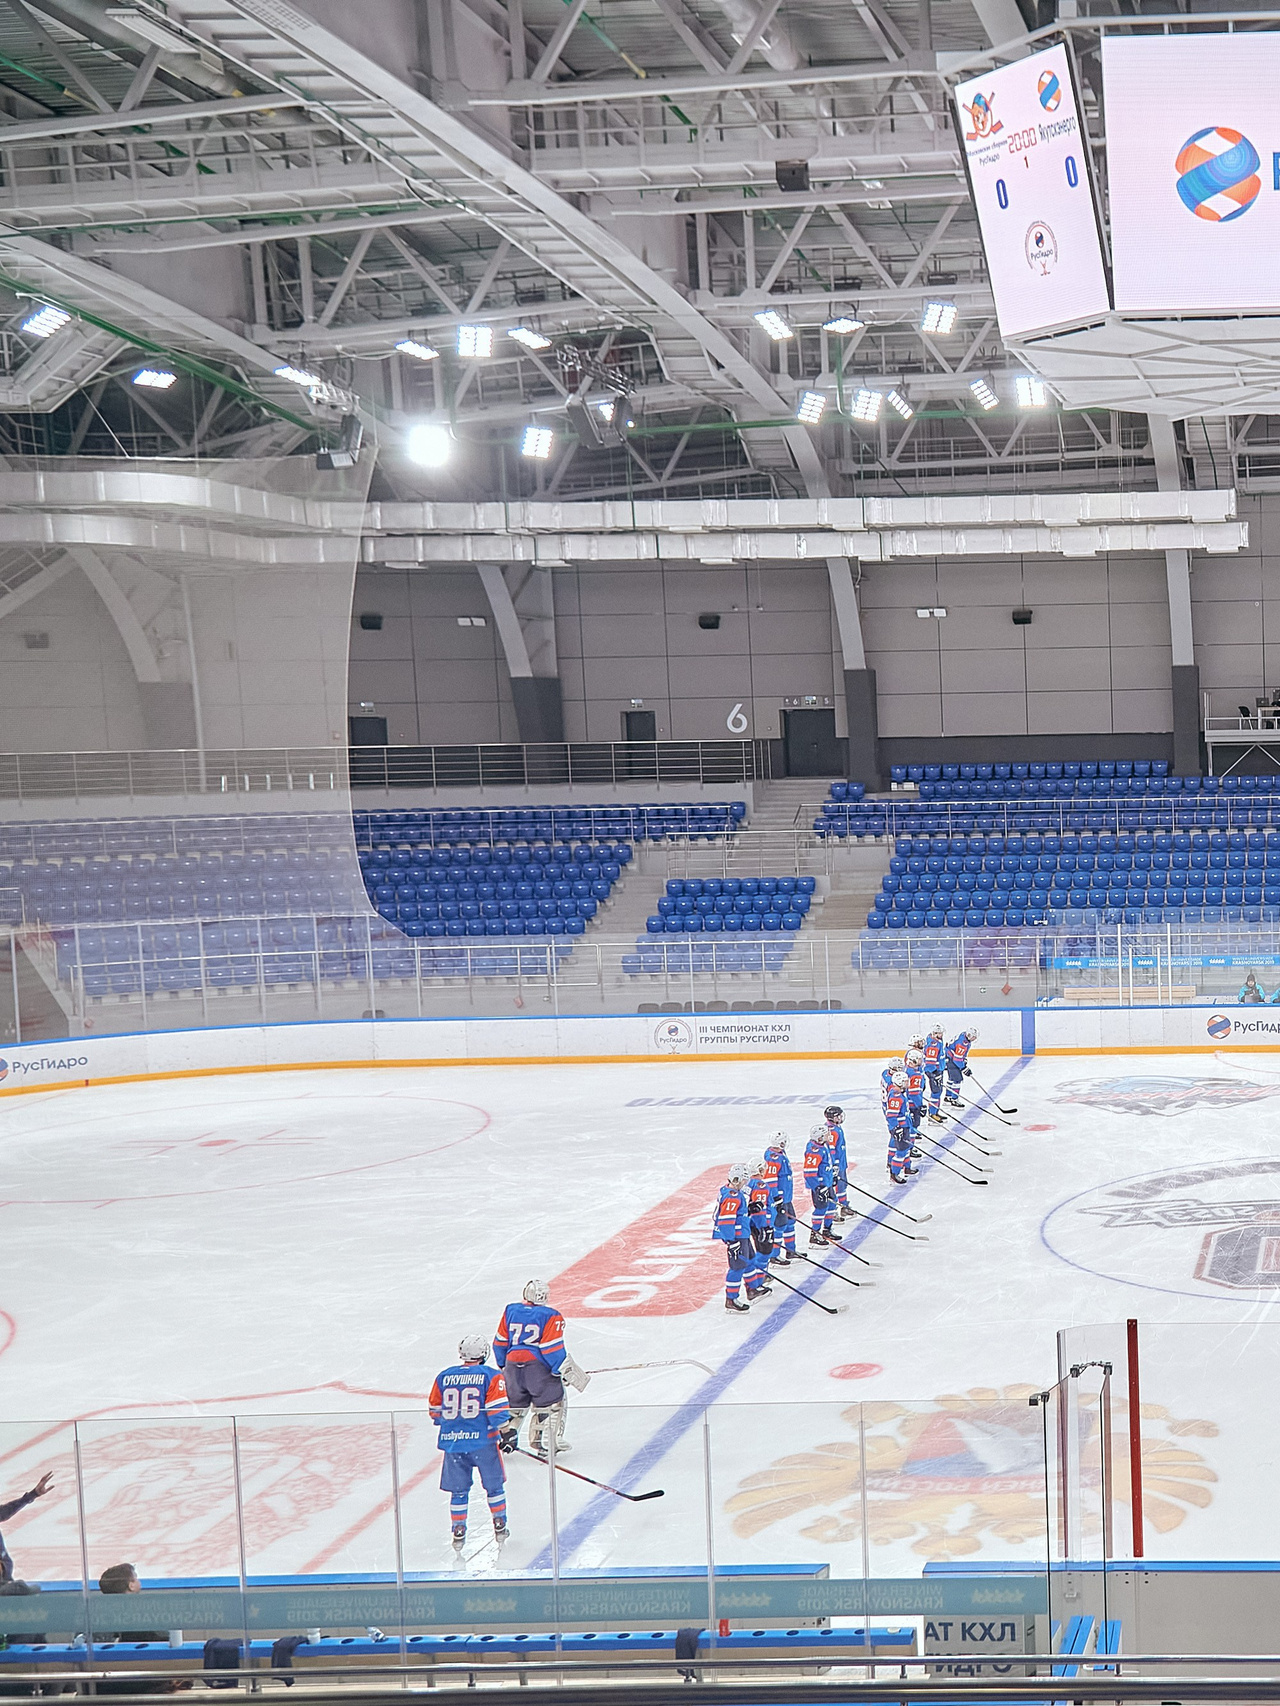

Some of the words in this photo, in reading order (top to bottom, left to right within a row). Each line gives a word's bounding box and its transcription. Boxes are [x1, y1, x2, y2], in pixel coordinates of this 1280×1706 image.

[1007, 127, 1038, 153] 20:00
[979, 154, 1000, 166] РусГидро
[1023, 155, 1029, 168] 1
[1065, 155, 1078, 188] 0
[996, 178, 1009, 209] 0
[726, 703, 748, 734] 6
[710, 1025, 769, 1033] ЧЕМПИОНАТ
[771, 1024, 791, 1032] КХЛ
[699, 1036, 738, 1044] ГРУППЫ
[740, 1035, 790, 1044] РУСГИДРО
[12, 1056, 88, 1074] РусГидро
[807, 1156, 817, 1165] 24
[768, 1166, 777, 1174] 10
[726, 1202, 737, 1211] 17
[509, 1323, 541, 1345] 72
[442, 1387, 480, 1420] 96
[440, 1430, 480, 1442] rushydro.ru
[961, 1621, 1016, 1642] КХЛ
